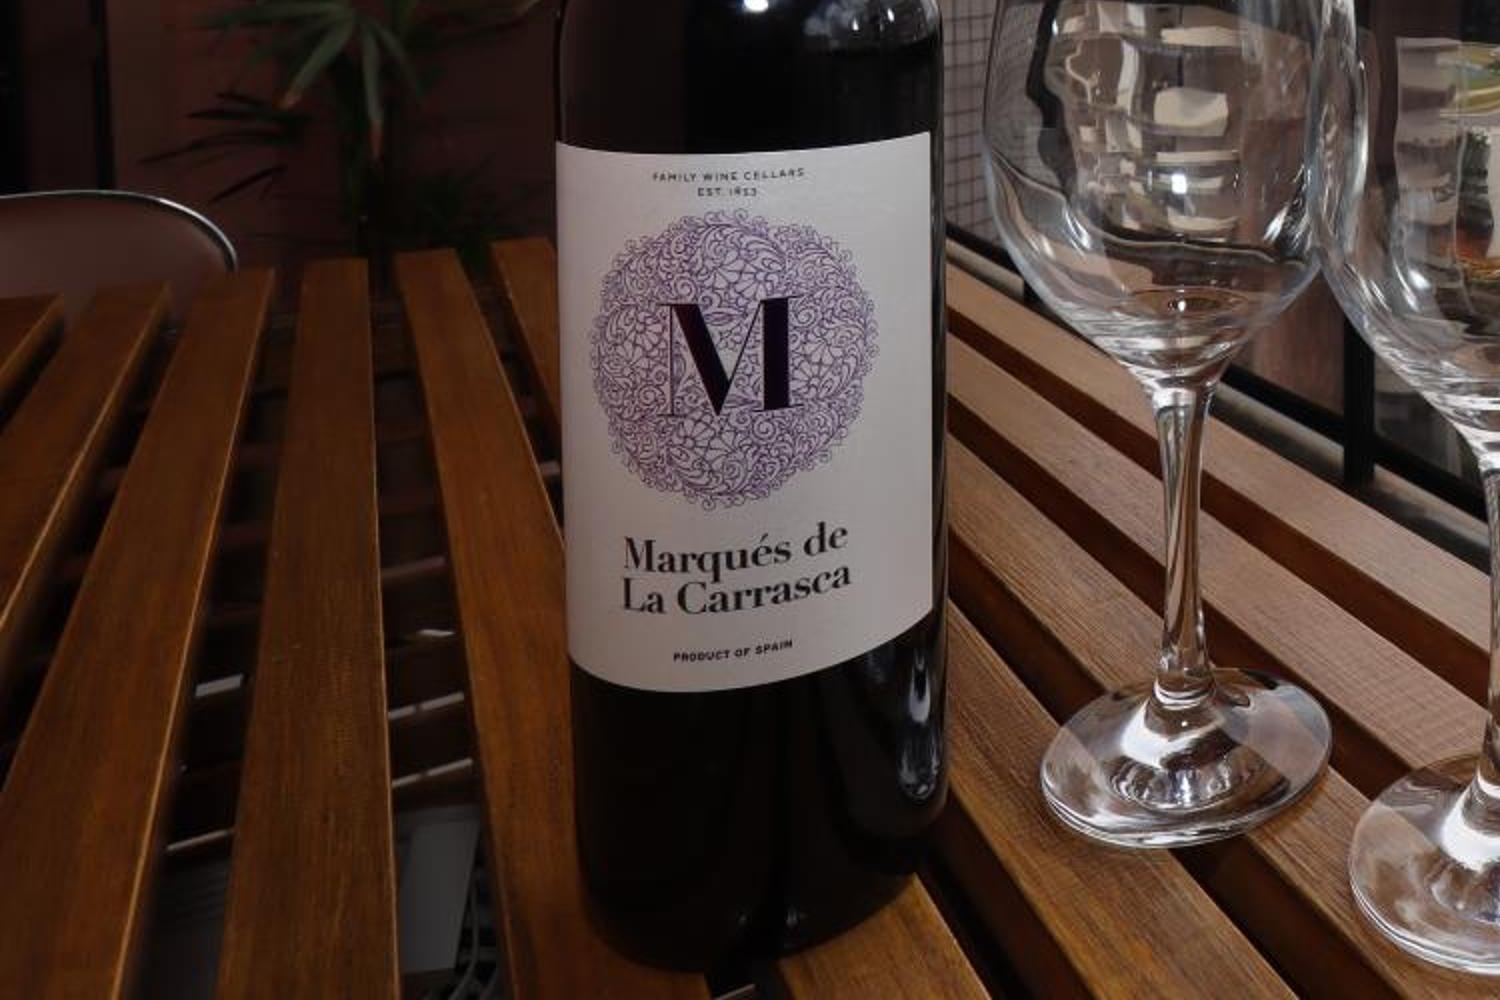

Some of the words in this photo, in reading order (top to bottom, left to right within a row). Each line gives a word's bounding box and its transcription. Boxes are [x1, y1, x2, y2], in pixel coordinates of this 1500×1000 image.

[652, 171, 697, 183] FAMILY
[703, 171, 737, 181] WINE
[743, 167, 805, 181] CELLARS
[655, 296, 804, 417] M
[624, 533, 792, 584] Marqués
[803, 521, 848, 557] de
[622, 576, 666, 614] La
[677, 565, 852, 615] Carrasca
[673, 649, 730, 663] PRODUCT
[734, 647, 751, 658] OF
[755, 639, 794, 655] SPAIN
